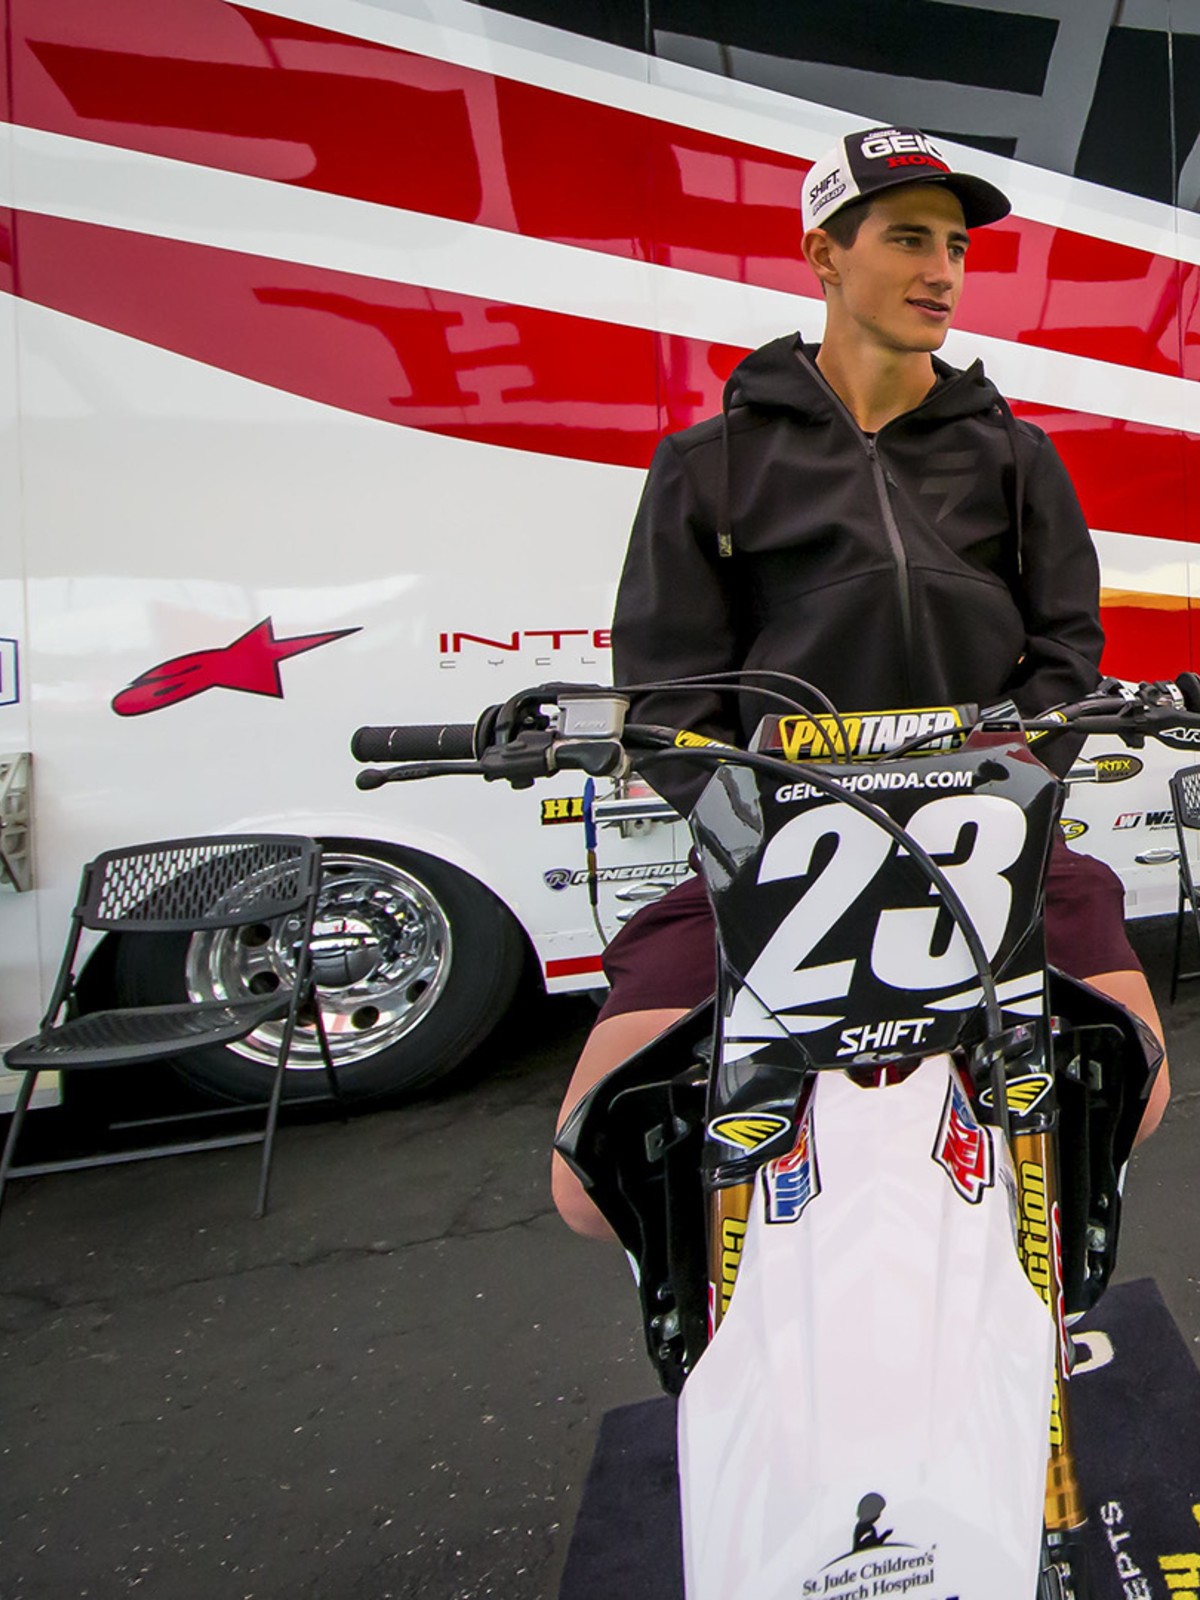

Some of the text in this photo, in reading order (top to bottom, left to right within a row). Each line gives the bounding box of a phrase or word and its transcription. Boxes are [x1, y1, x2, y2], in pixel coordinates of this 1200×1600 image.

[810, 168, 840, 205] SHIFT
[738, 795, 1028, 1014] 23
[835, 1017, 936, 1057] SHIFT
[802, 1552, 935, 1596] St. Jude Children's
[872, 1569, 935, 1597] Hospital
